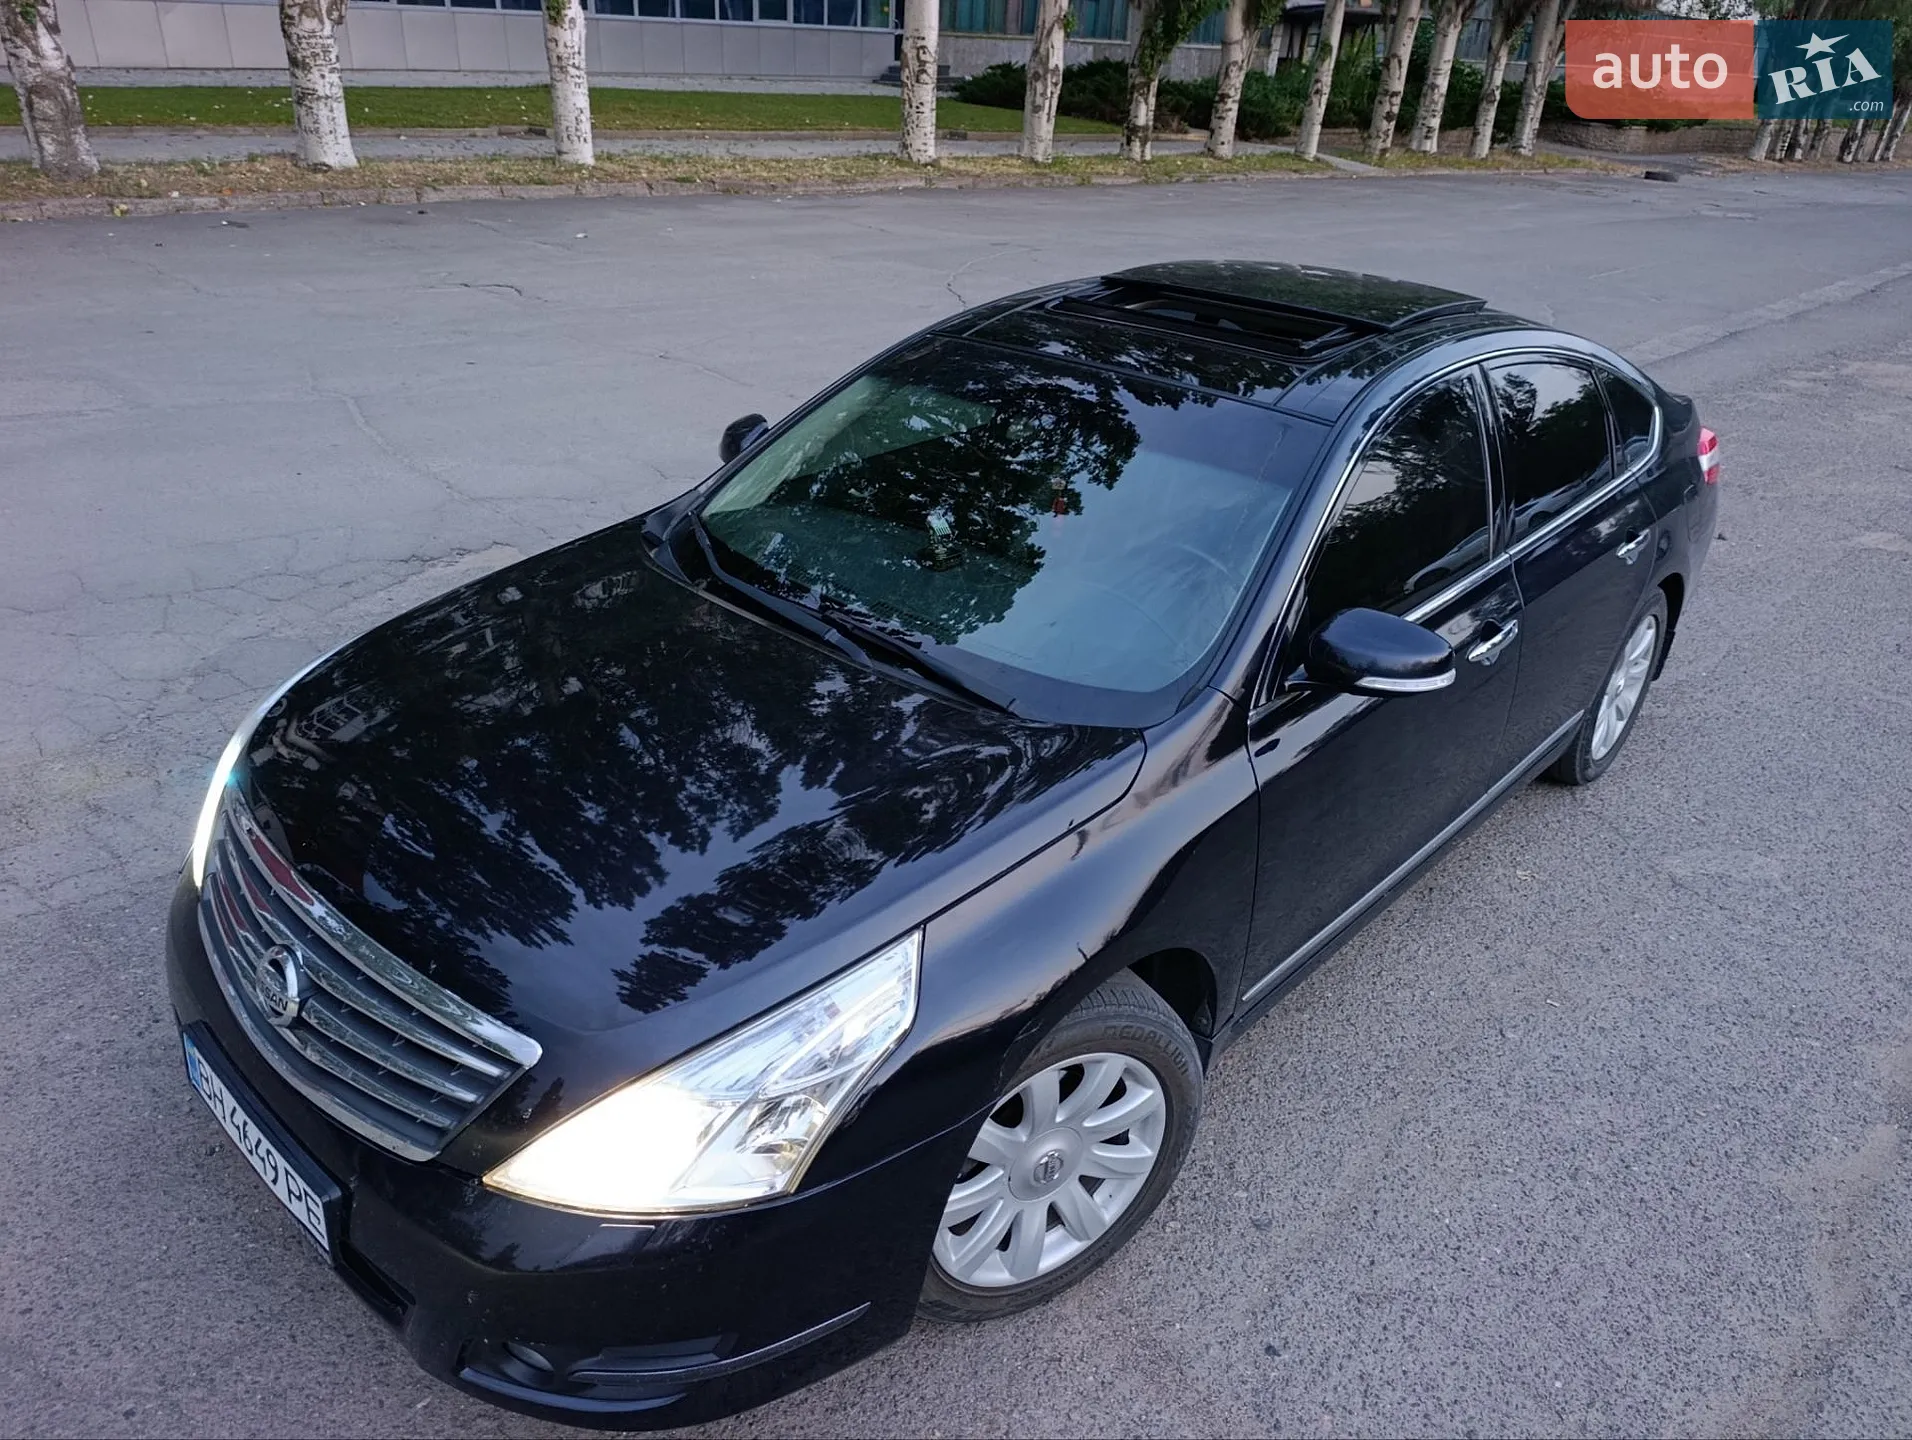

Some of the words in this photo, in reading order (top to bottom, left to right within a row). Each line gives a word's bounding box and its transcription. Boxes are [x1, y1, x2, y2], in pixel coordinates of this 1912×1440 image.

[197, 1057, 227, 1123] BH
[230, 1106, 279, 1186] 4649
[284, 1167, 326, 1239] PE
